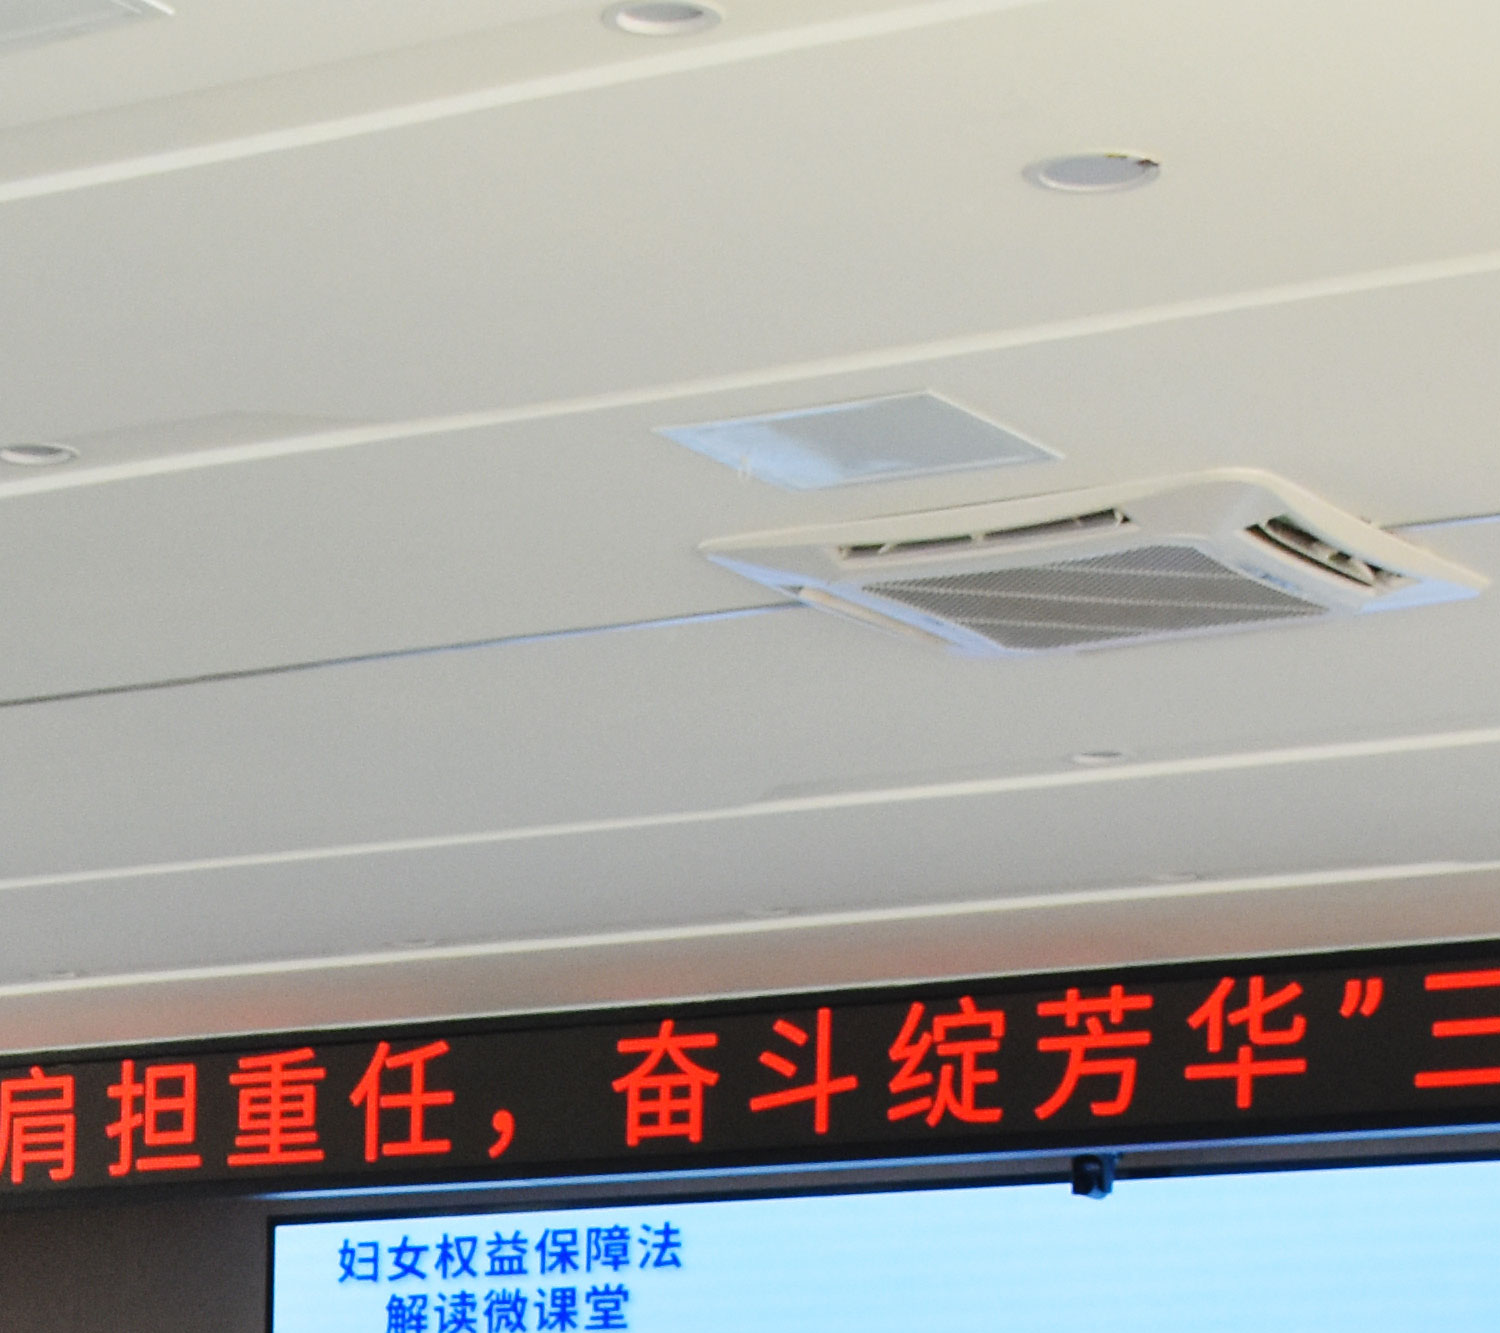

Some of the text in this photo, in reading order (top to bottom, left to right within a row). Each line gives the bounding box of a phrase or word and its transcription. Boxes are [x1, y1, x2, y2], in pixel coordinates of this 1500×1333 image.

[337, 1220, 684, 1284] 妇女权益保障法
